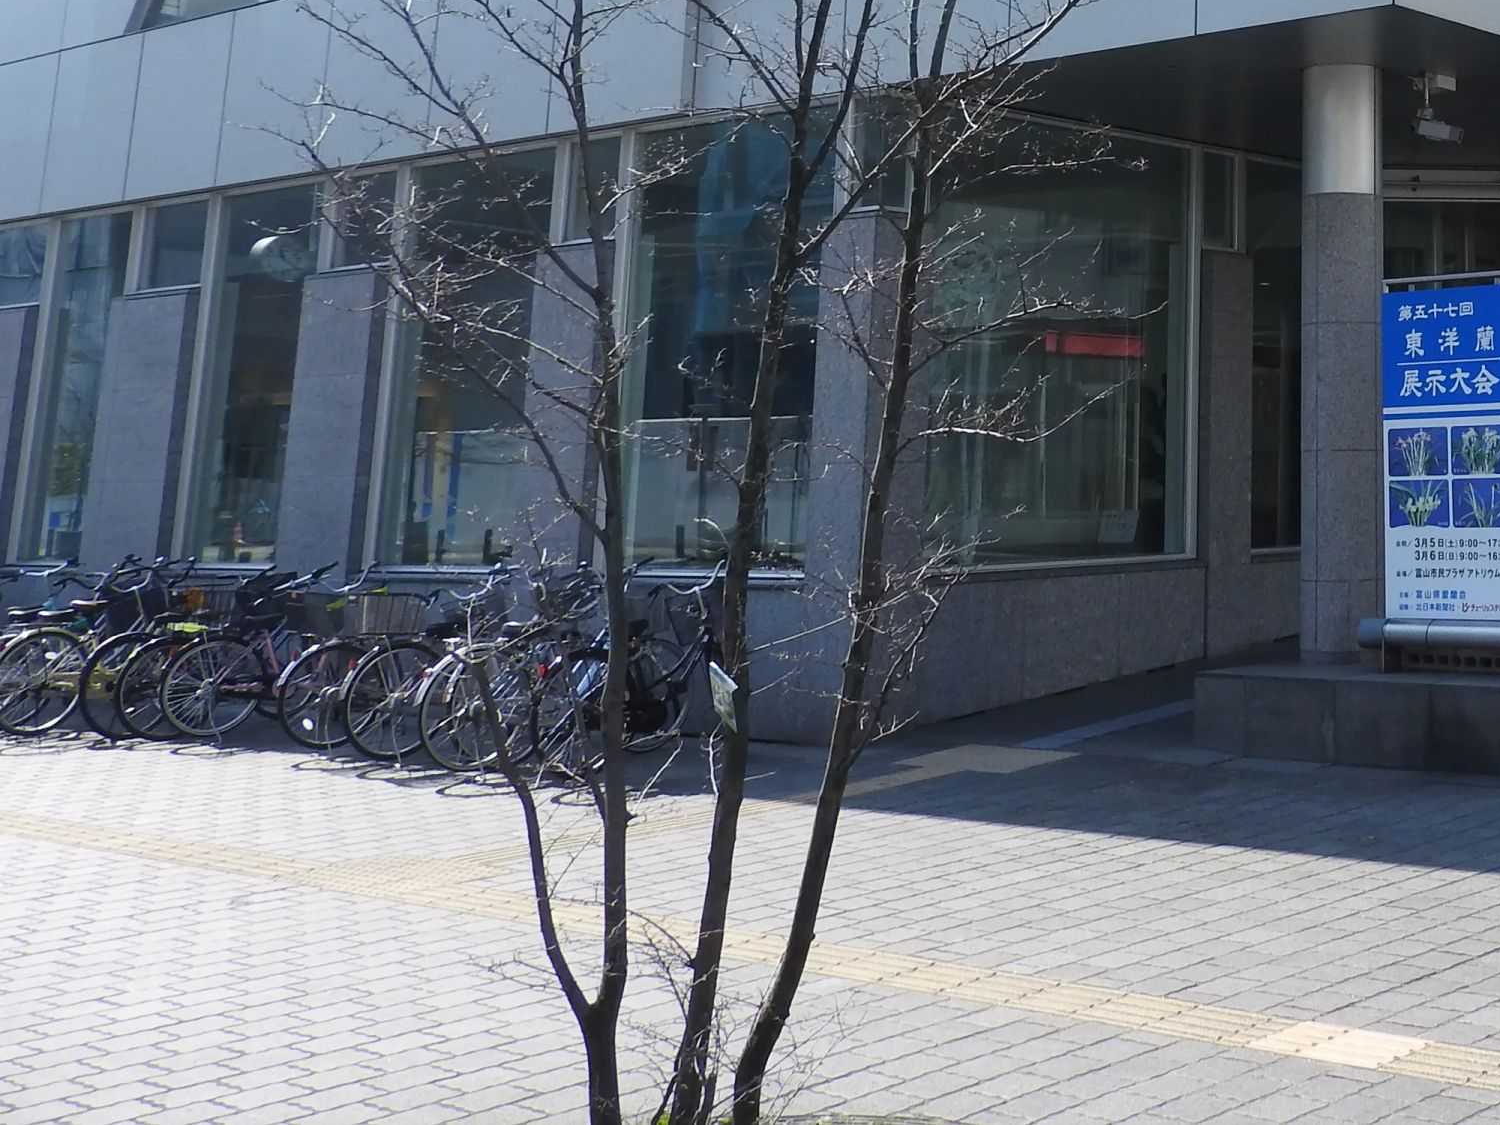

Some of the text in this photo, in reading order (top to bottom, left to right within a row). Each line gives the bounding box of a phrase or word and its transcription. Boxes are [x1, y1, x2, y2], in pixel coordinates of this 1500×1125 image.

[1398, 301, 1474, 321] 第五十七回
[1404, 325, 1495, 358] 東洋蘭
[1400, 364, 1500, 397] 展示大会
